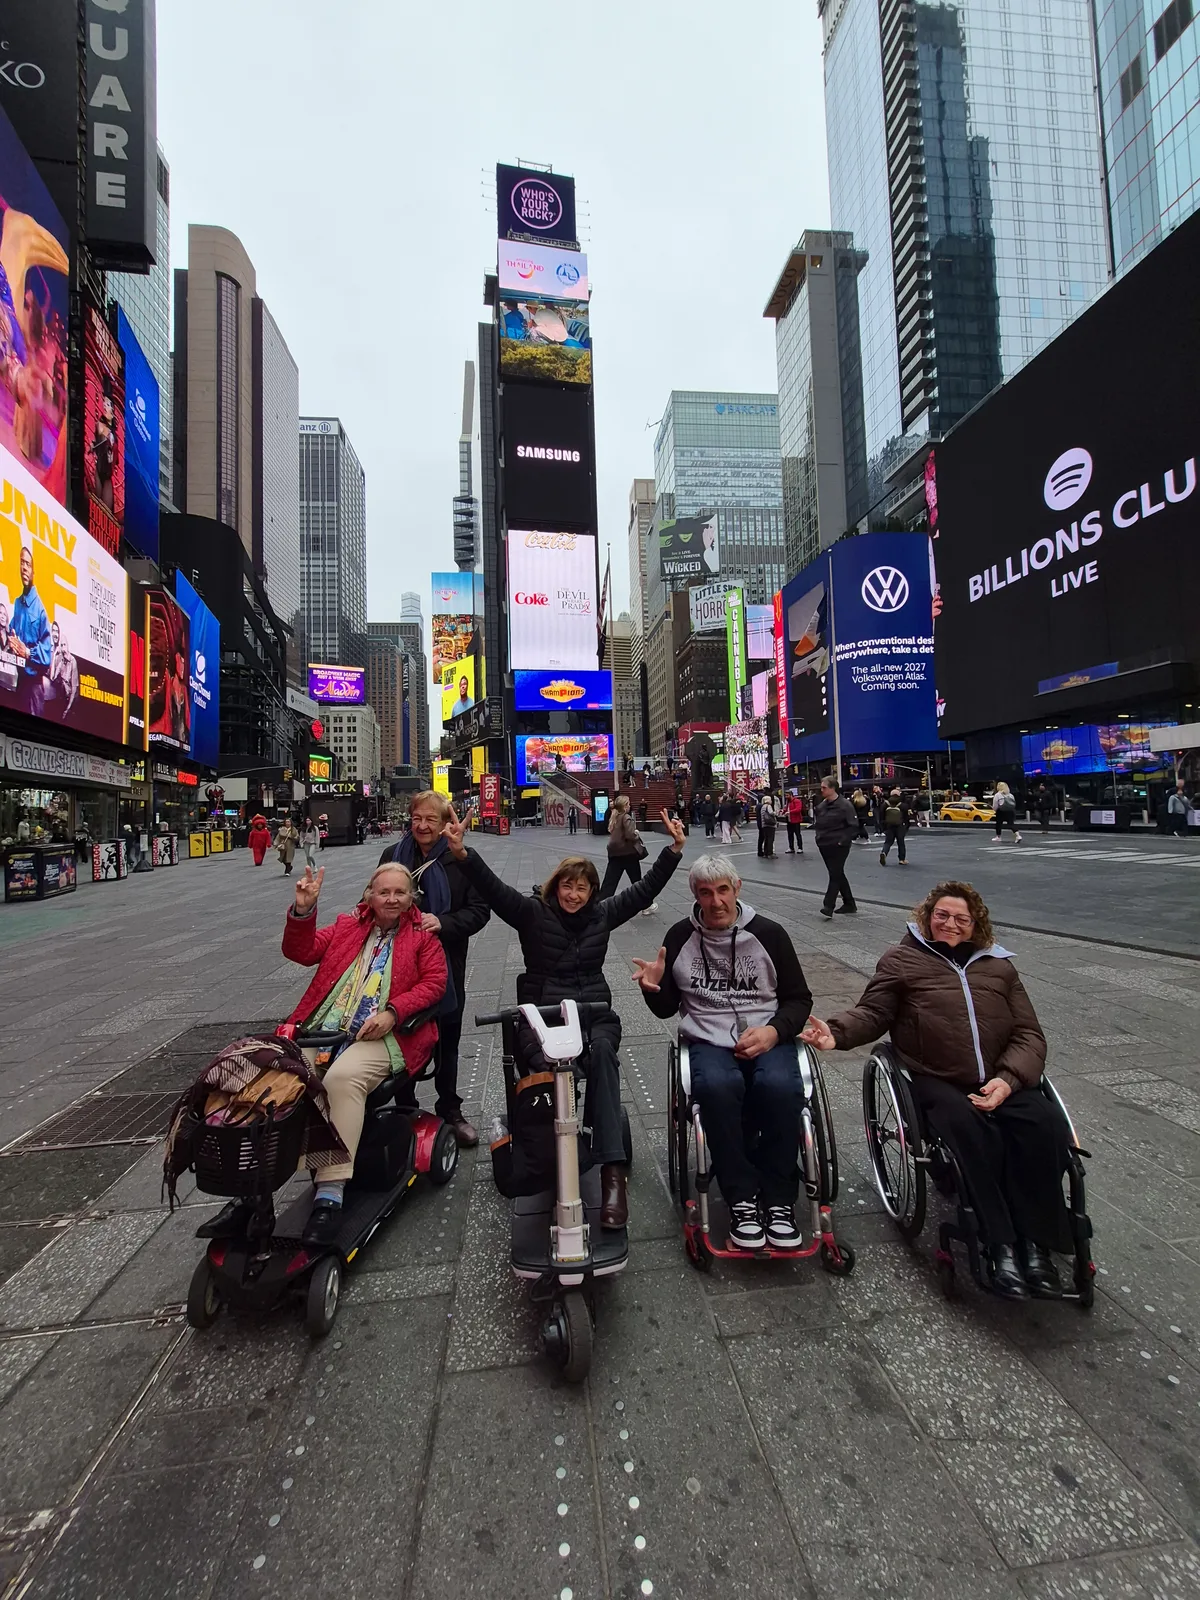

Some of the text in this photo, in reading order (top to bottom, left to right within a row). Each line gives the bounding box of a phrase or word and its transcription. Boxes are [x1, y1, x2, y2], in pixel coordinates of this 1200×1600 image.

[520, 187, 555, 203] WHO'S
[521, 198, 549, 212] YOUR
[521, 207, 554, 222] ROCK?
[506, 259, 545, 272] THAILAND
[727, 403, 777, 416] BARCLAYS
[516, 445, 581, 463] SAMSUNG
[968, 457, 1198, 603] BILLIONS CLU
[1051, 560, 1099, 598] LIVE
[514, 591, 550, 606] Coke
[557, 589, 590, 600] DEVIL
[695, 584, 722, 602] LITTLE
[857, 635, 916, 648] conventional
[917, 636, 935, 645] desi
[731, 608, 742, 704] CANNABIS
[836, 646, 890, 661] everywhere,
[892, 645, 911, 654] take
[919, 645, 935, 654] det
[851, 662, 926, 675] The all-new 2027
[776, 636, 788, 719] HERSHEY'S STORE
[852, 672, 927, 684] Volkswagen Atlas.
[313, 681, 360, 698] Aladdin
[861, 681, 920, 692] Coming soon.
[11, 740, 56, 774] GRAND
[56, 750, 86, 778] SLAM
[311, 782, 357, 794] KLIKTIX
[485, 775, 498, 800] tkts
[93, 843, 102, 881] CHICAGO
[690, 976, 759, 991] ZUZENAK
